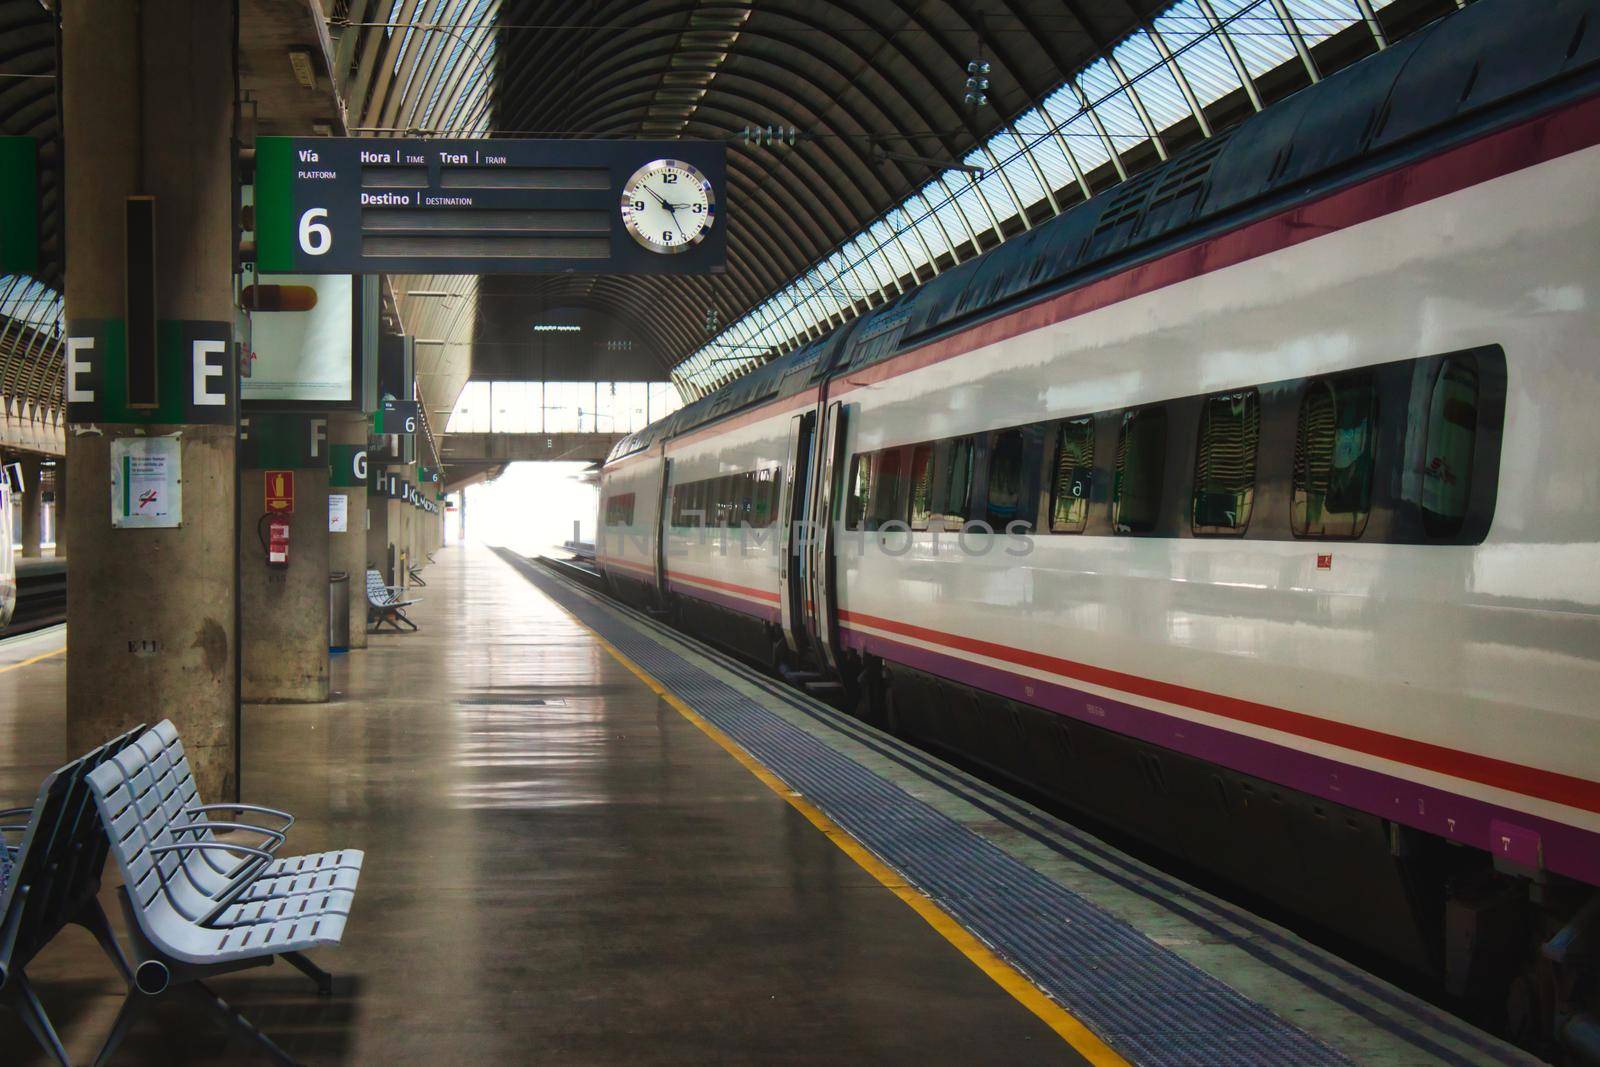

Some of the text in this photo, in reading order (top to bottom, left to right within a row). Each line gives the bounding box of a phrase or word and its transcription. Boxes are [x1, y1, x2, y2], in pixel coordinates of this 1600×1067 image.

[298, 150, 319, 162] Vía
[360, 151, 390, 163] Hora
[440, 152, 468, 164] Tren
[298, 171, 336, 179] PLATFORM
[662, 173, 677, 184] 12
[360, 193, 472, 206] Destino DESTINATION
[634, 201, 645, 212] 9
[692, 203, 702, 214] 3
[298, 207, 332, 256] 6
[662, 231, 673, 242] 6
[67, 337, 95, 402] E
[193, 340, 226, 406] E
[405, 416, 415, 433] 6
[310, 419, 327, 457] F
[353, 451, 367, 479] G
[402, 483, 409, 499] J
